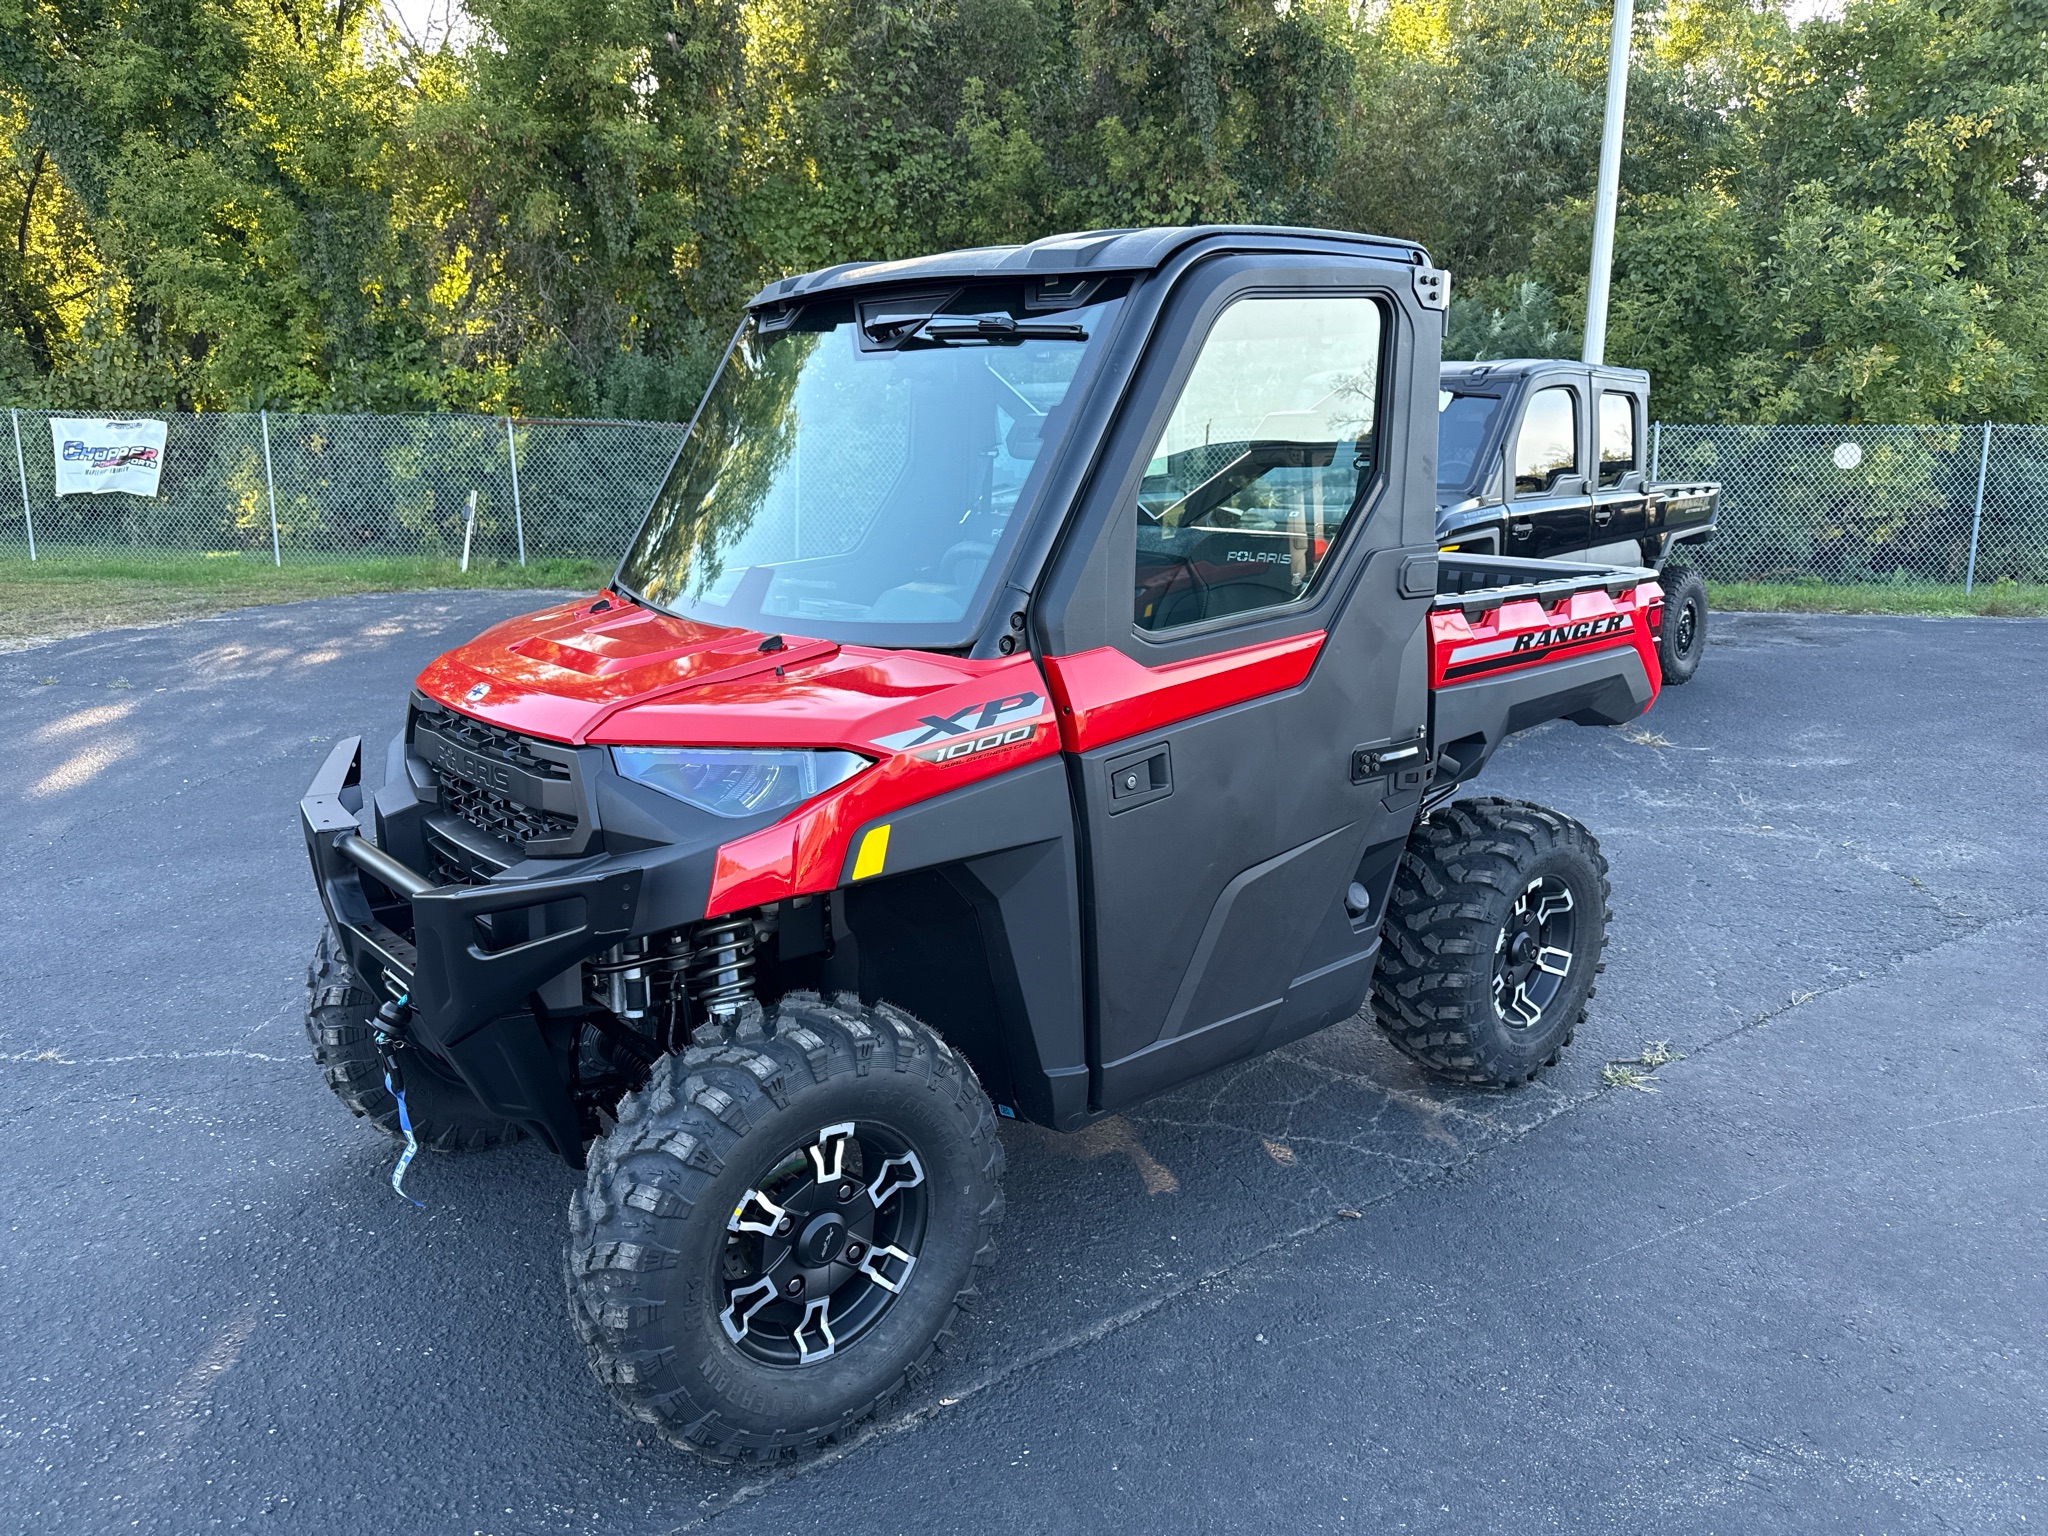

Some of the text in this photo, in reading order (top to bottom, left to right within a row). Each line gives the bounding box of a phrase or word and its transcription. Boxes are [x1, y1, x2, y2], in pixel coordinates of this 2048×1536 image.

[63, 441, 158, 461] CHOPPER
[1226, 551, 1292, 564] POLARIS
[1512, 614, 1625, 653] RANGER
[902, 691, 1041, 749] XP
[936, 725, 1031, 762] 1000
[438, 745, 510, 793] POLARIS
[392, 1130, 418, 1198] POLAR
